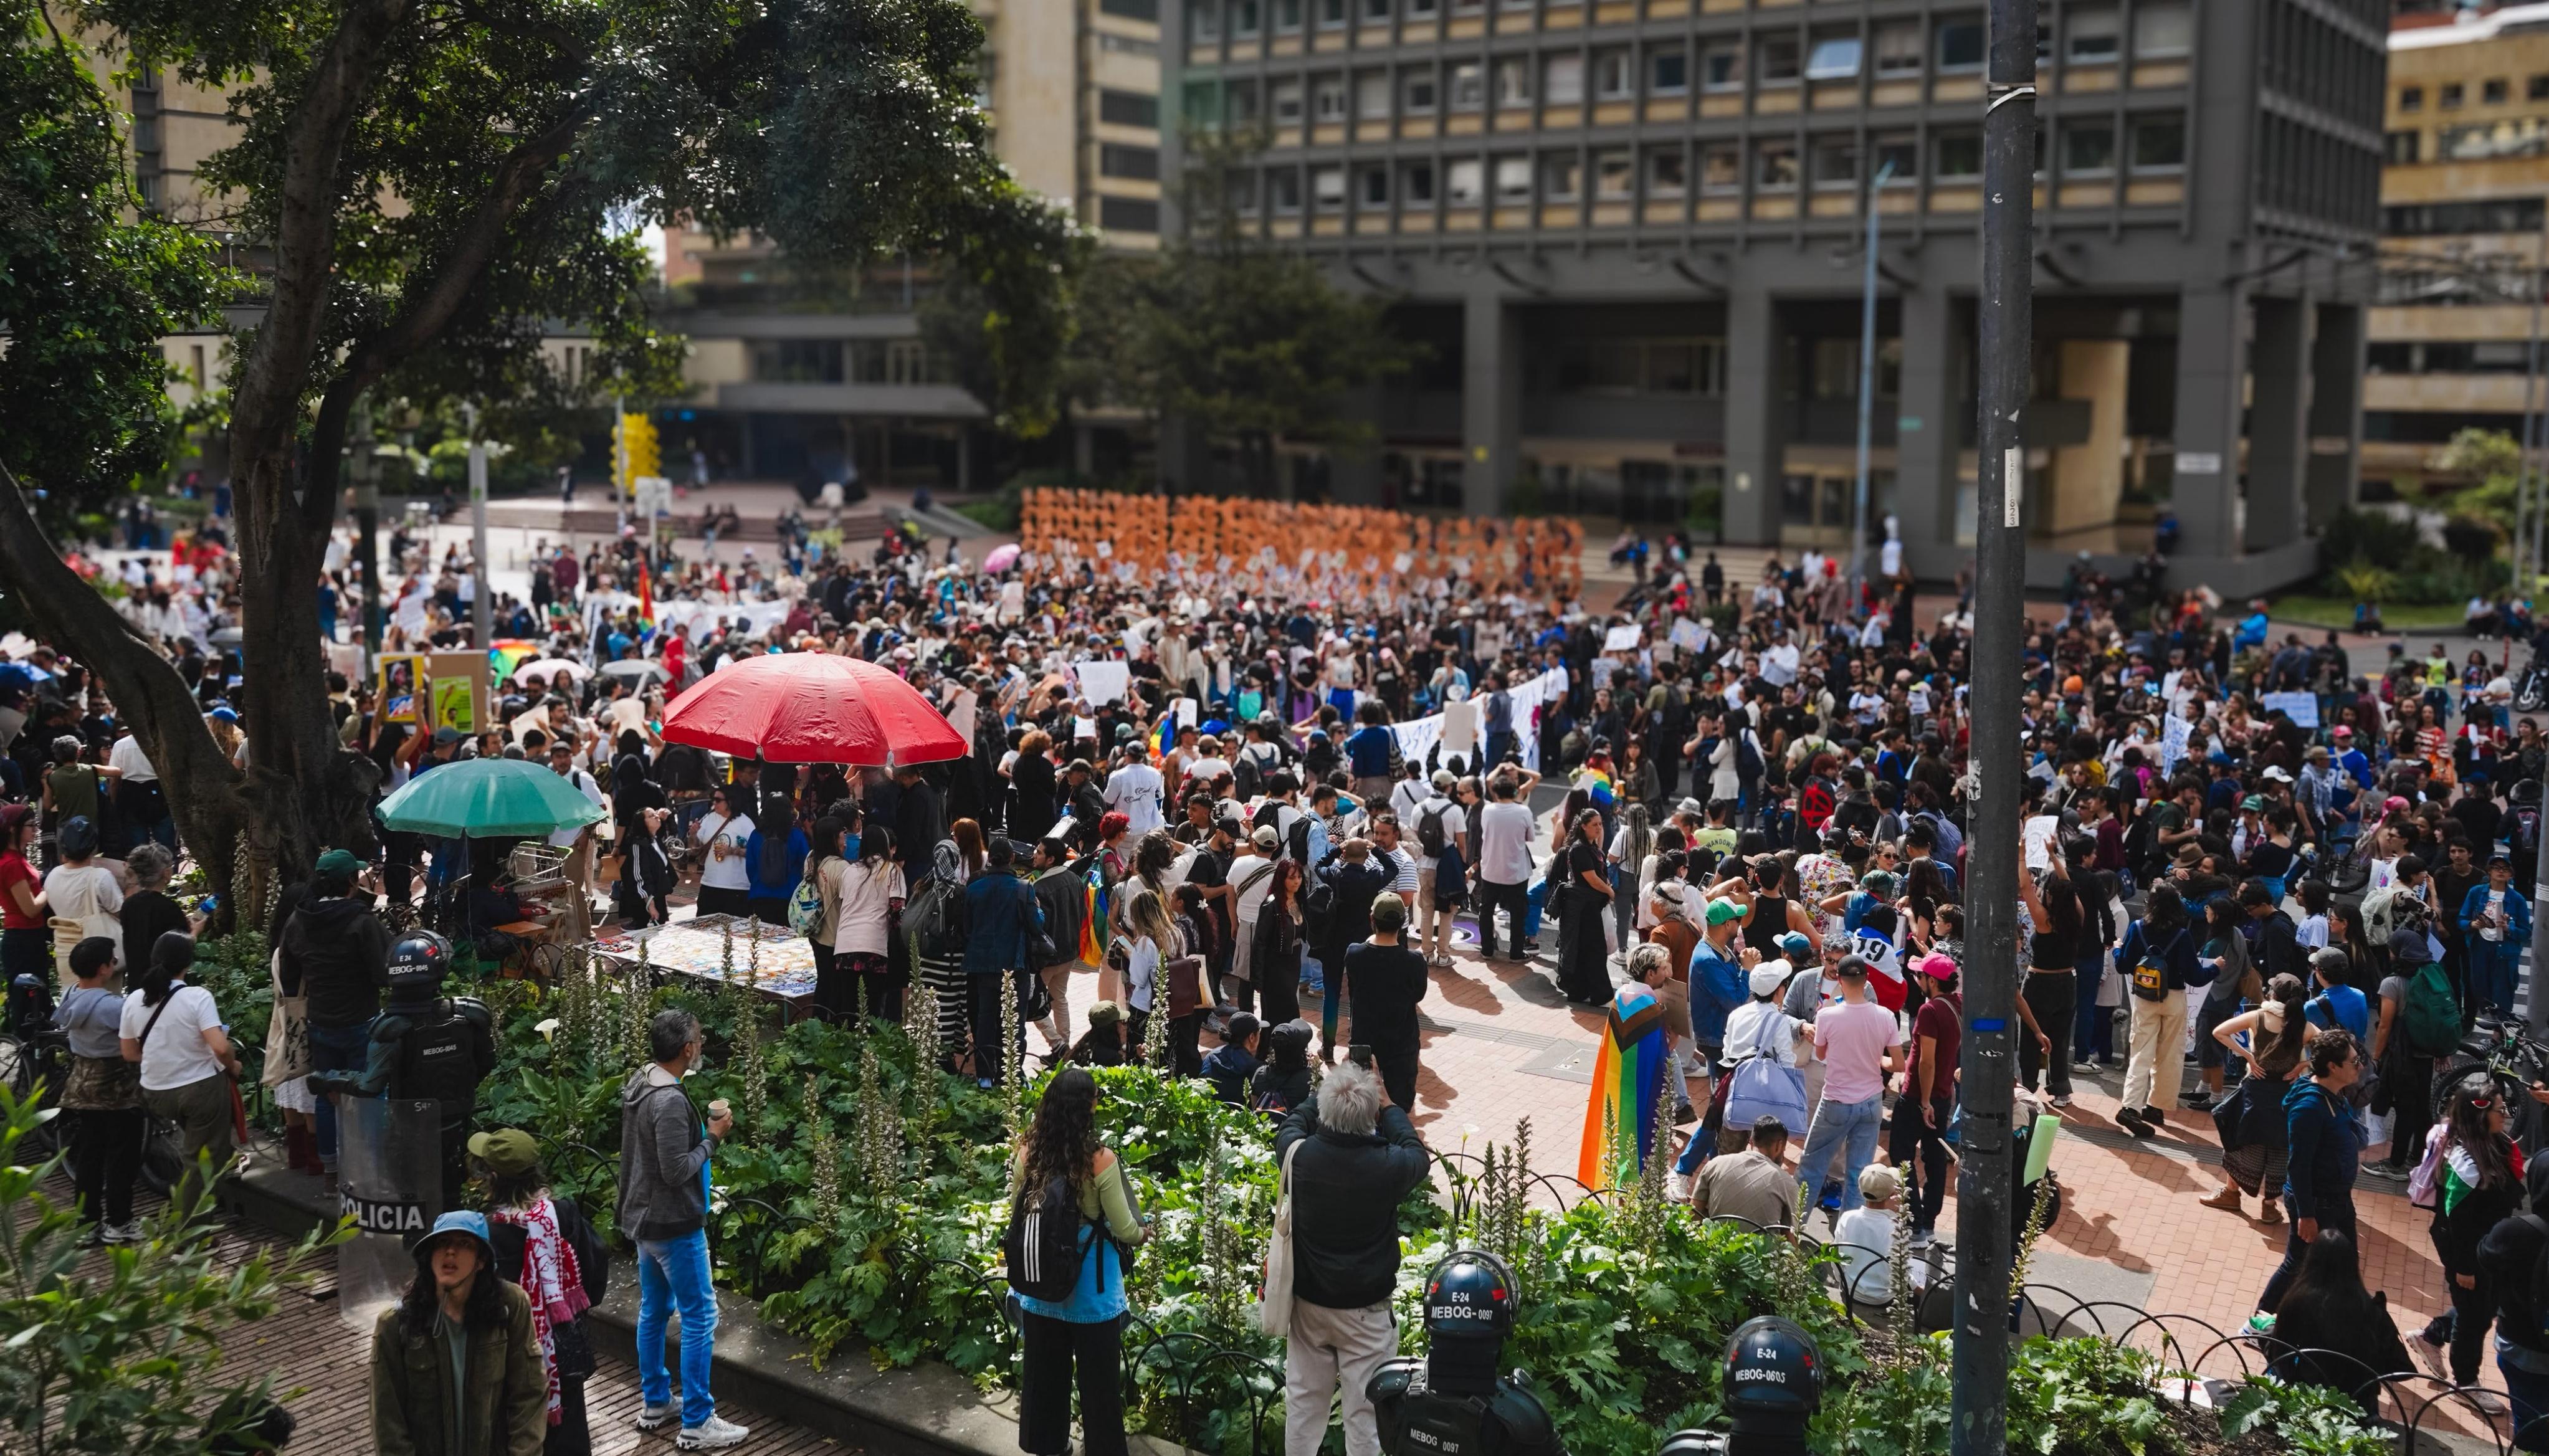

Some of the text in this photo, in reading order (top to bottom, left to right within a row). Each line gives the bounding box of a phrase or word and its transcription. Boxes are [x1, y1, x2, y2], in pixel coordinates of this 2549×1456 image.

[340, 1191, 426, 1230] POLICIA
[1452, 1292, 1469, 1303] E-24
[1757, 1348, 1776, 1360] E-24
[1410, 1427, 1459, 1454] MEBOG 0097
